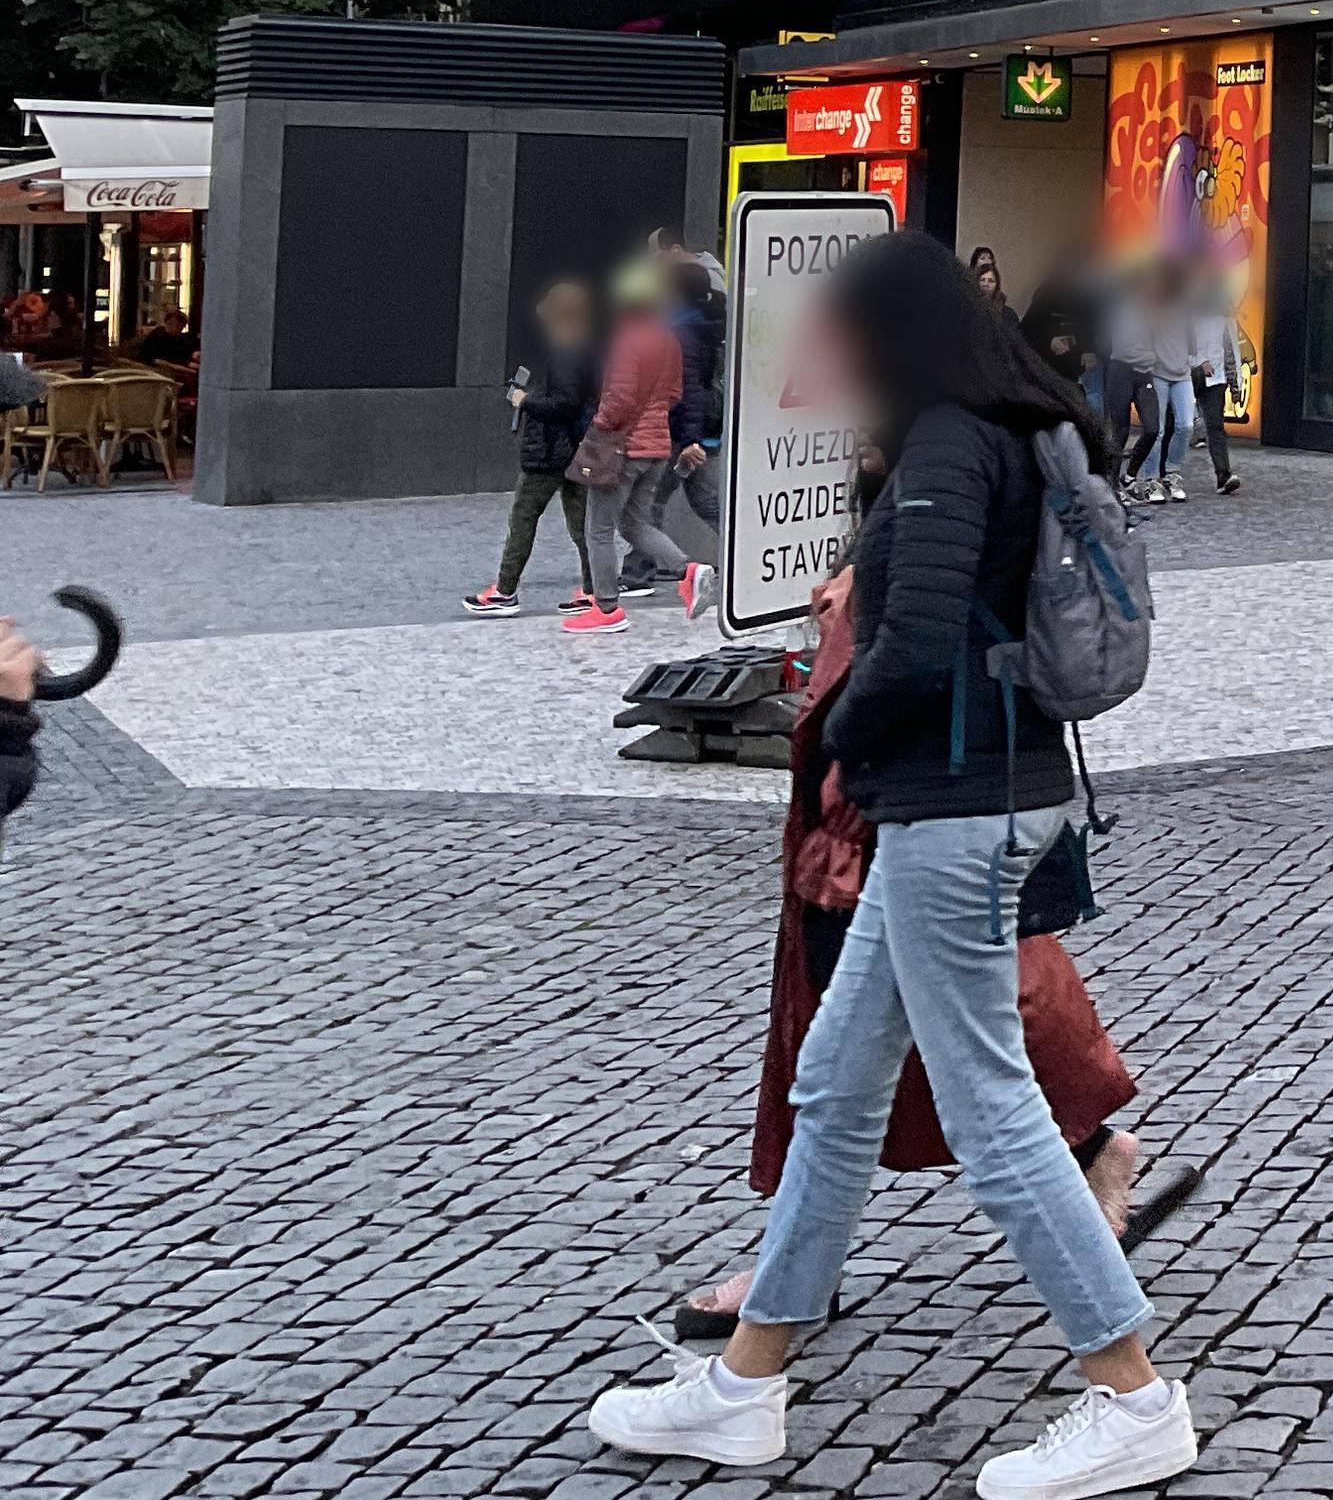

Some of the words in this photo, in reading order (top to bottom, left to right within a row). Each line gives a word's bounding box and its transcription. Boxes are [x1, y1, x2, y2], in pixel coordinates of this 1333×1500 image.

[1217, 65, 1236, 84] Foot
[1237, 64, 1264, 82] Locker
[897, 84, 916, 145] change
[86, 180, 181, 208] Coca-Cola
[872, 164, 903, 185] change
[767, 428, 857, 471] VÝJEZD
[757, 482, 848, 528] VOZIDE
[761, 535, 849, 583] STAVB
